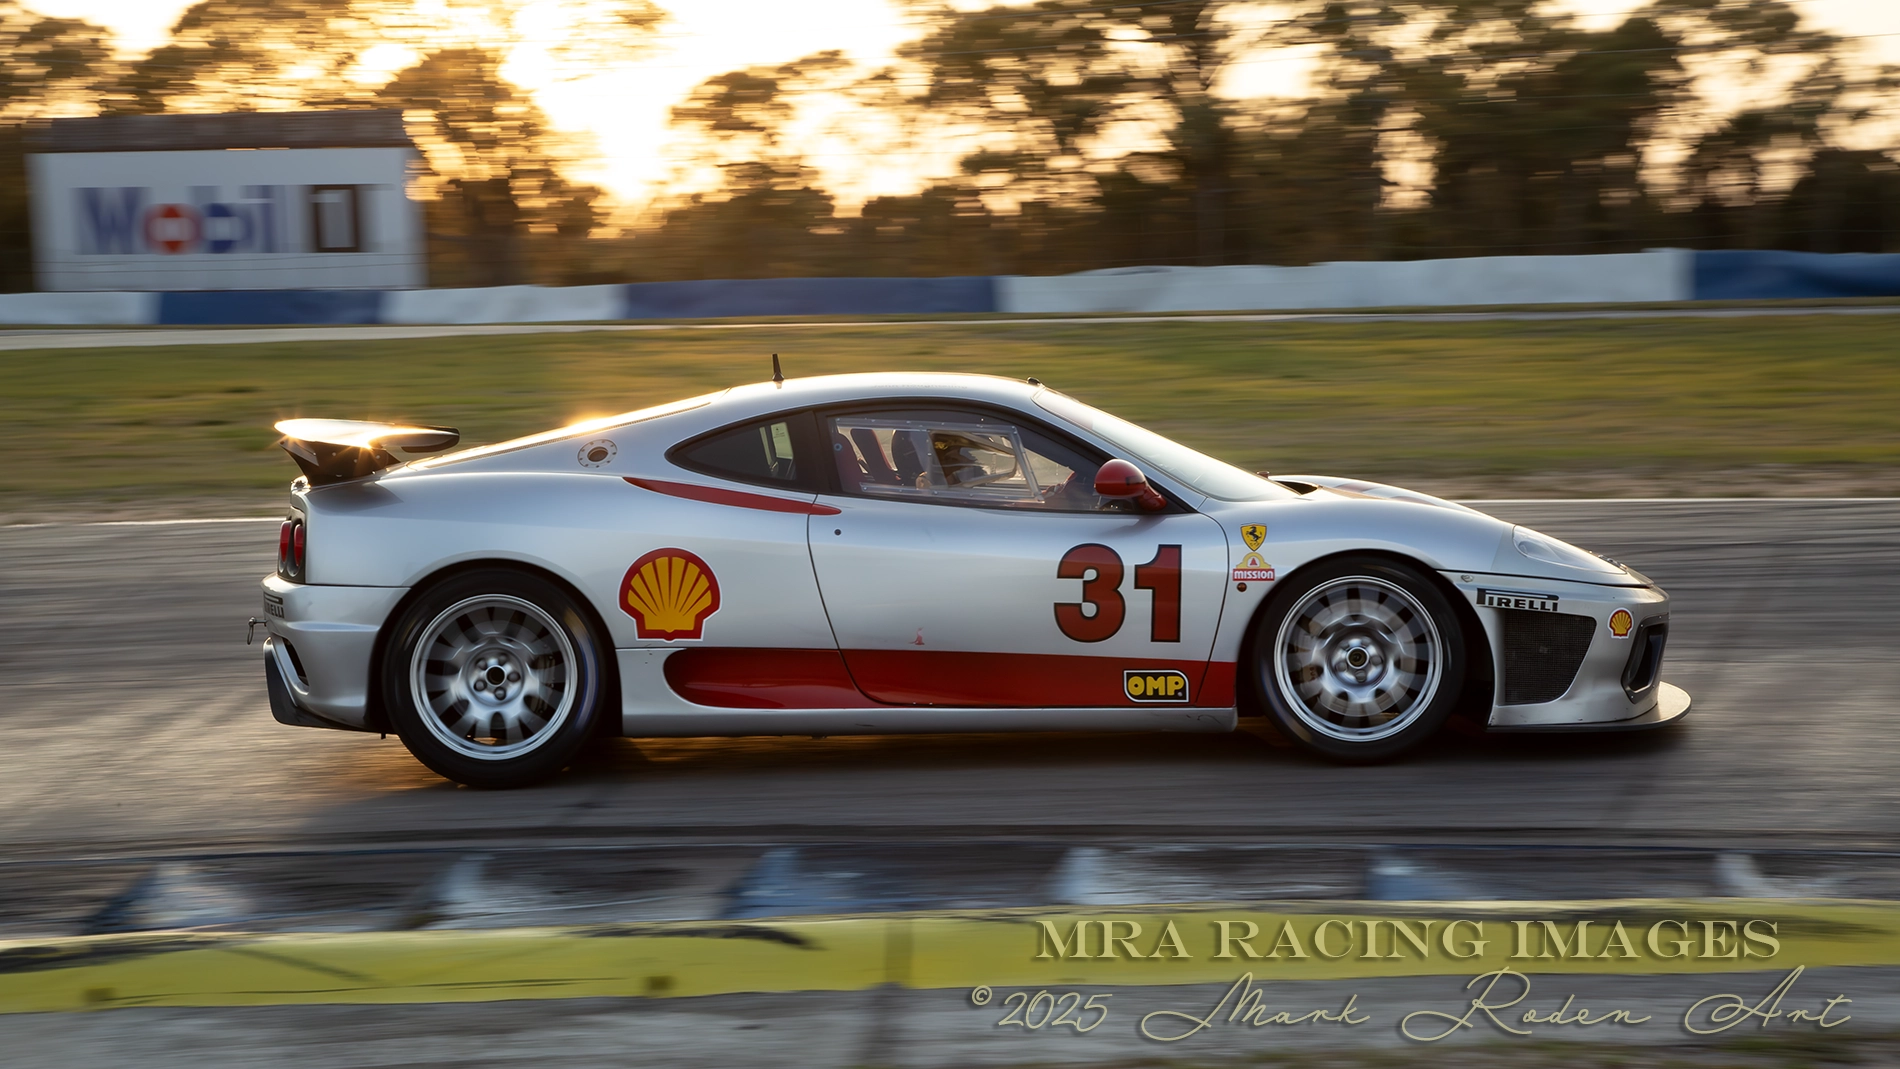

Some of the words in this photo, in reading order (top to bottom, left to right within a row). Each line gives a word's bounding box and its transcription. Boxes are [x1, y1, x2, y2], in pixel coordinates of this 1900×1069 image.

[72, 186, 286, 254] Mobil
[1054, 543, 1182, 643] 31
[1476, 587, 1559, 611] PIRELLI
[1128, 675, 1185, 696] OMP
